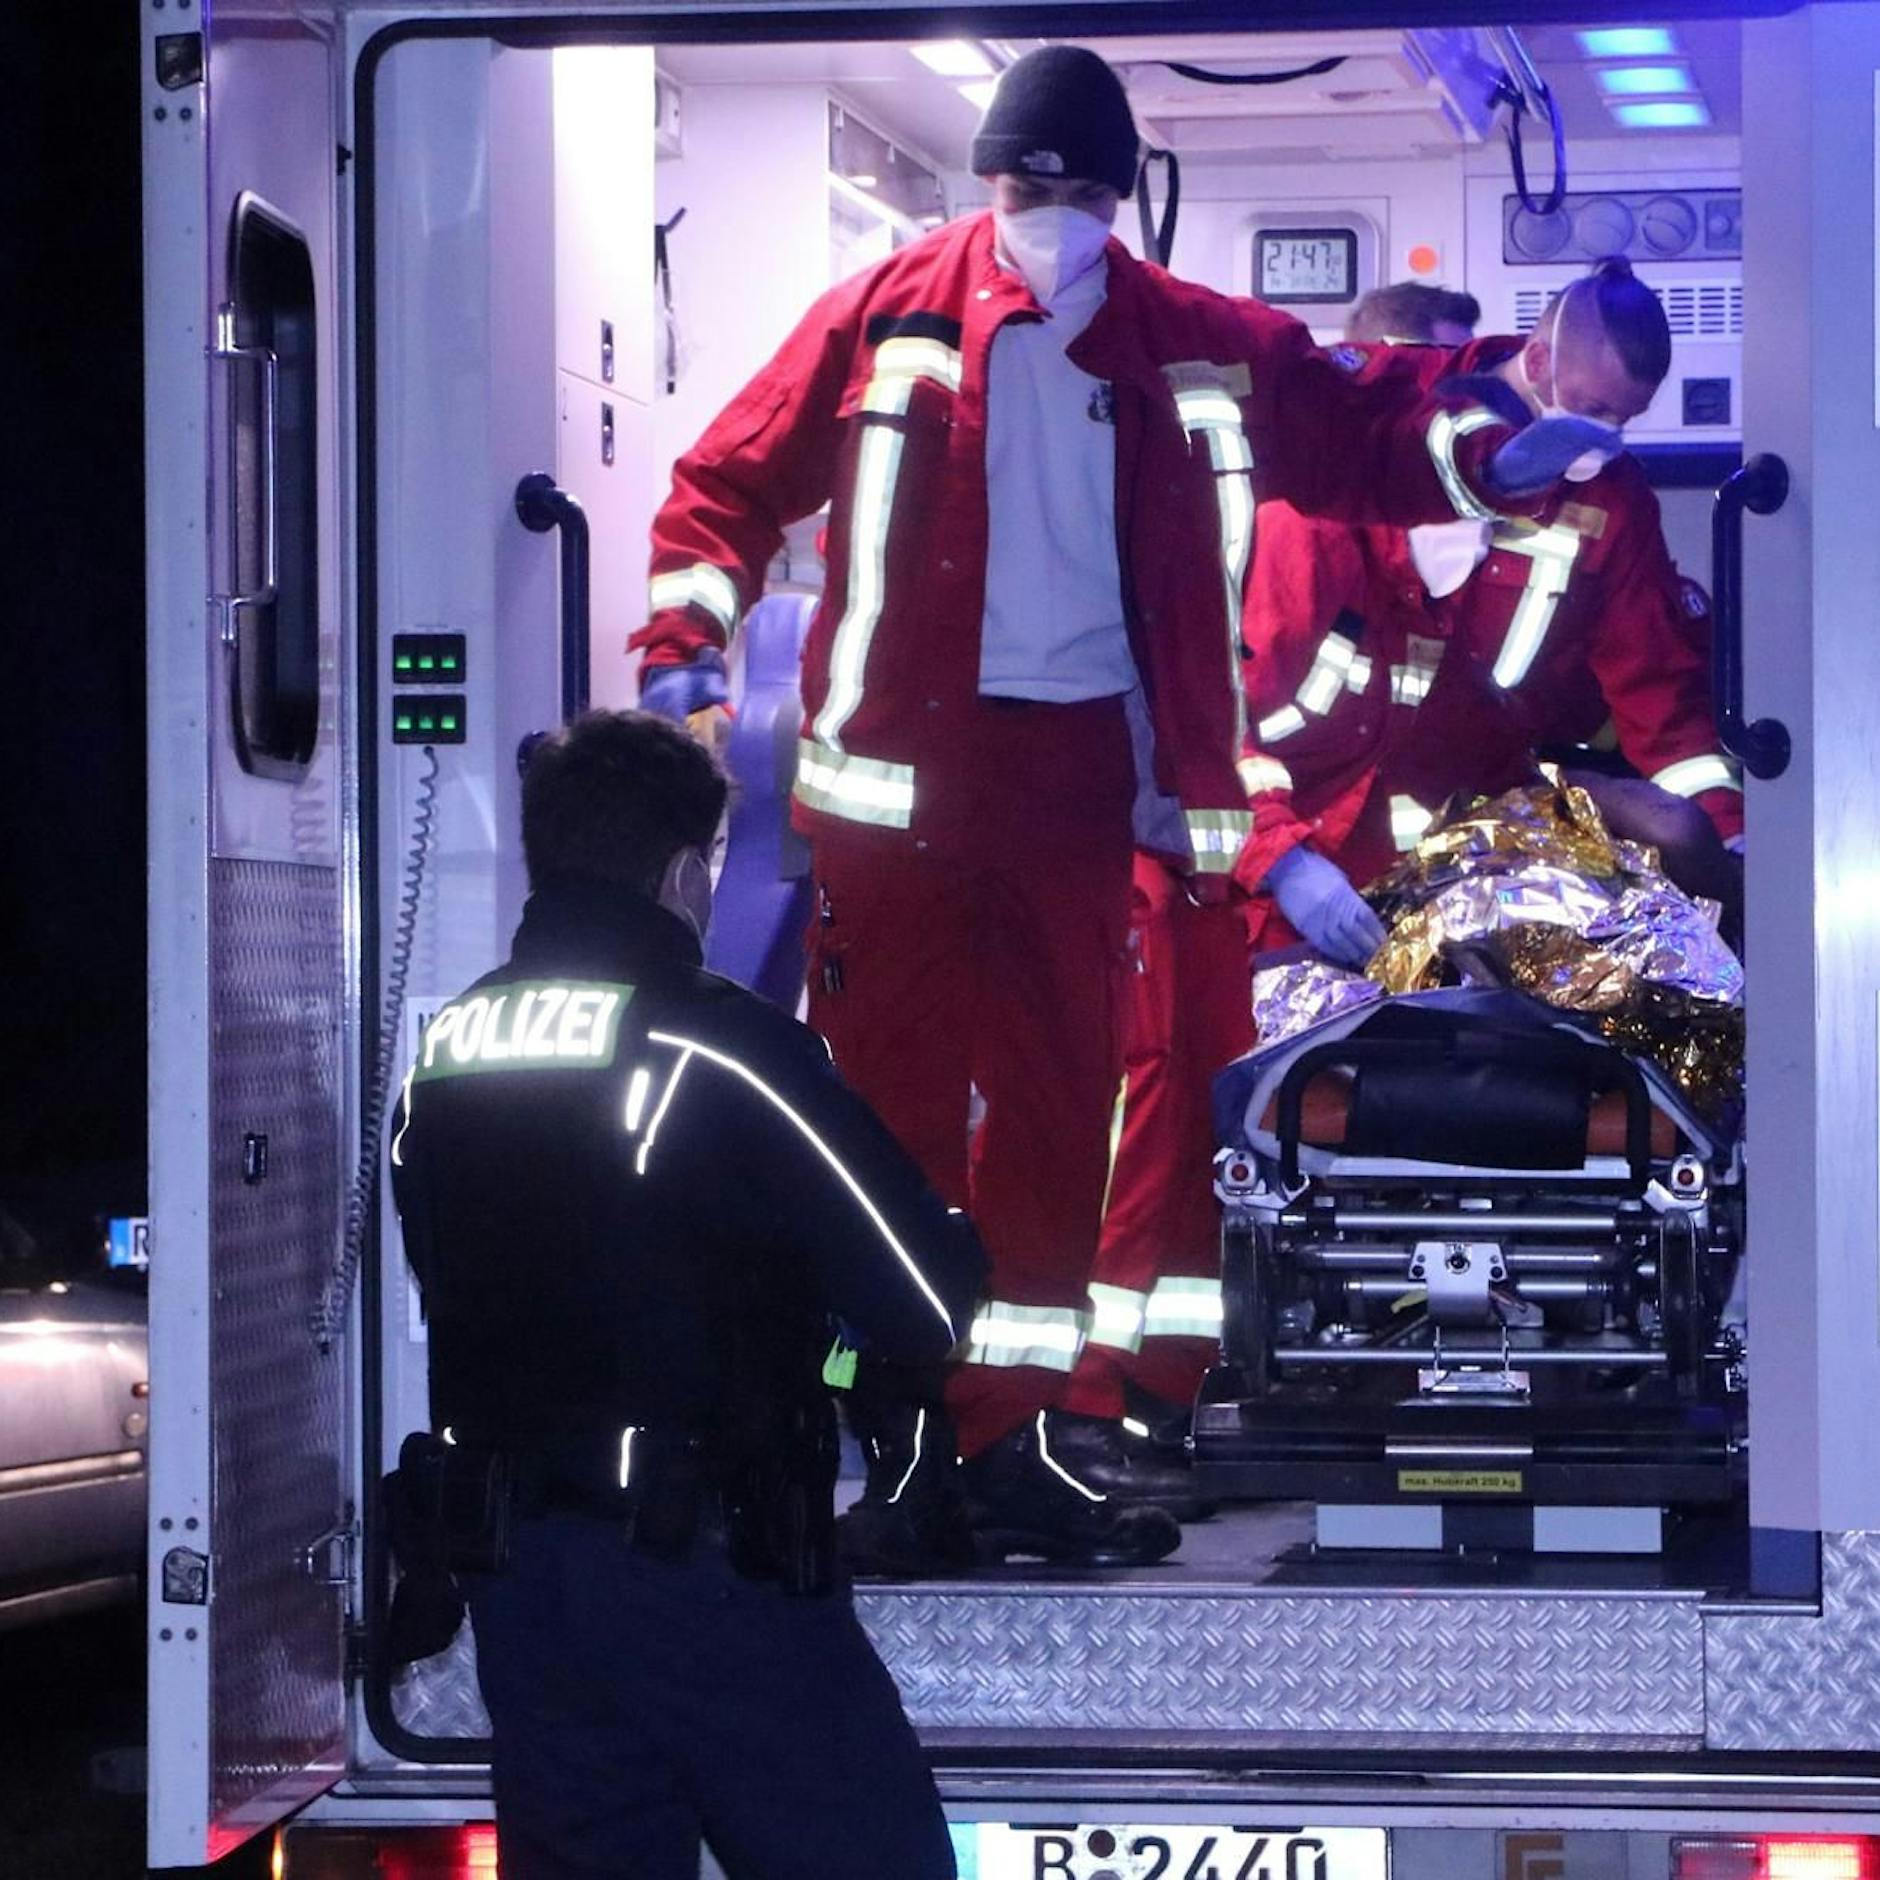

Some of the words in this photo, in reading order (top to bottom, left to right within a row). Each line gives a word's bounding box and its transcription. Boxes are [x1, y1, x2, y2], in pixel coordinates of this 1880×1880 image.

[423, 987, 620, 1068] POLIZEI
[1502, 1477, 1516, 1488] kg
[1033, 1835, 1075, 1880] B
